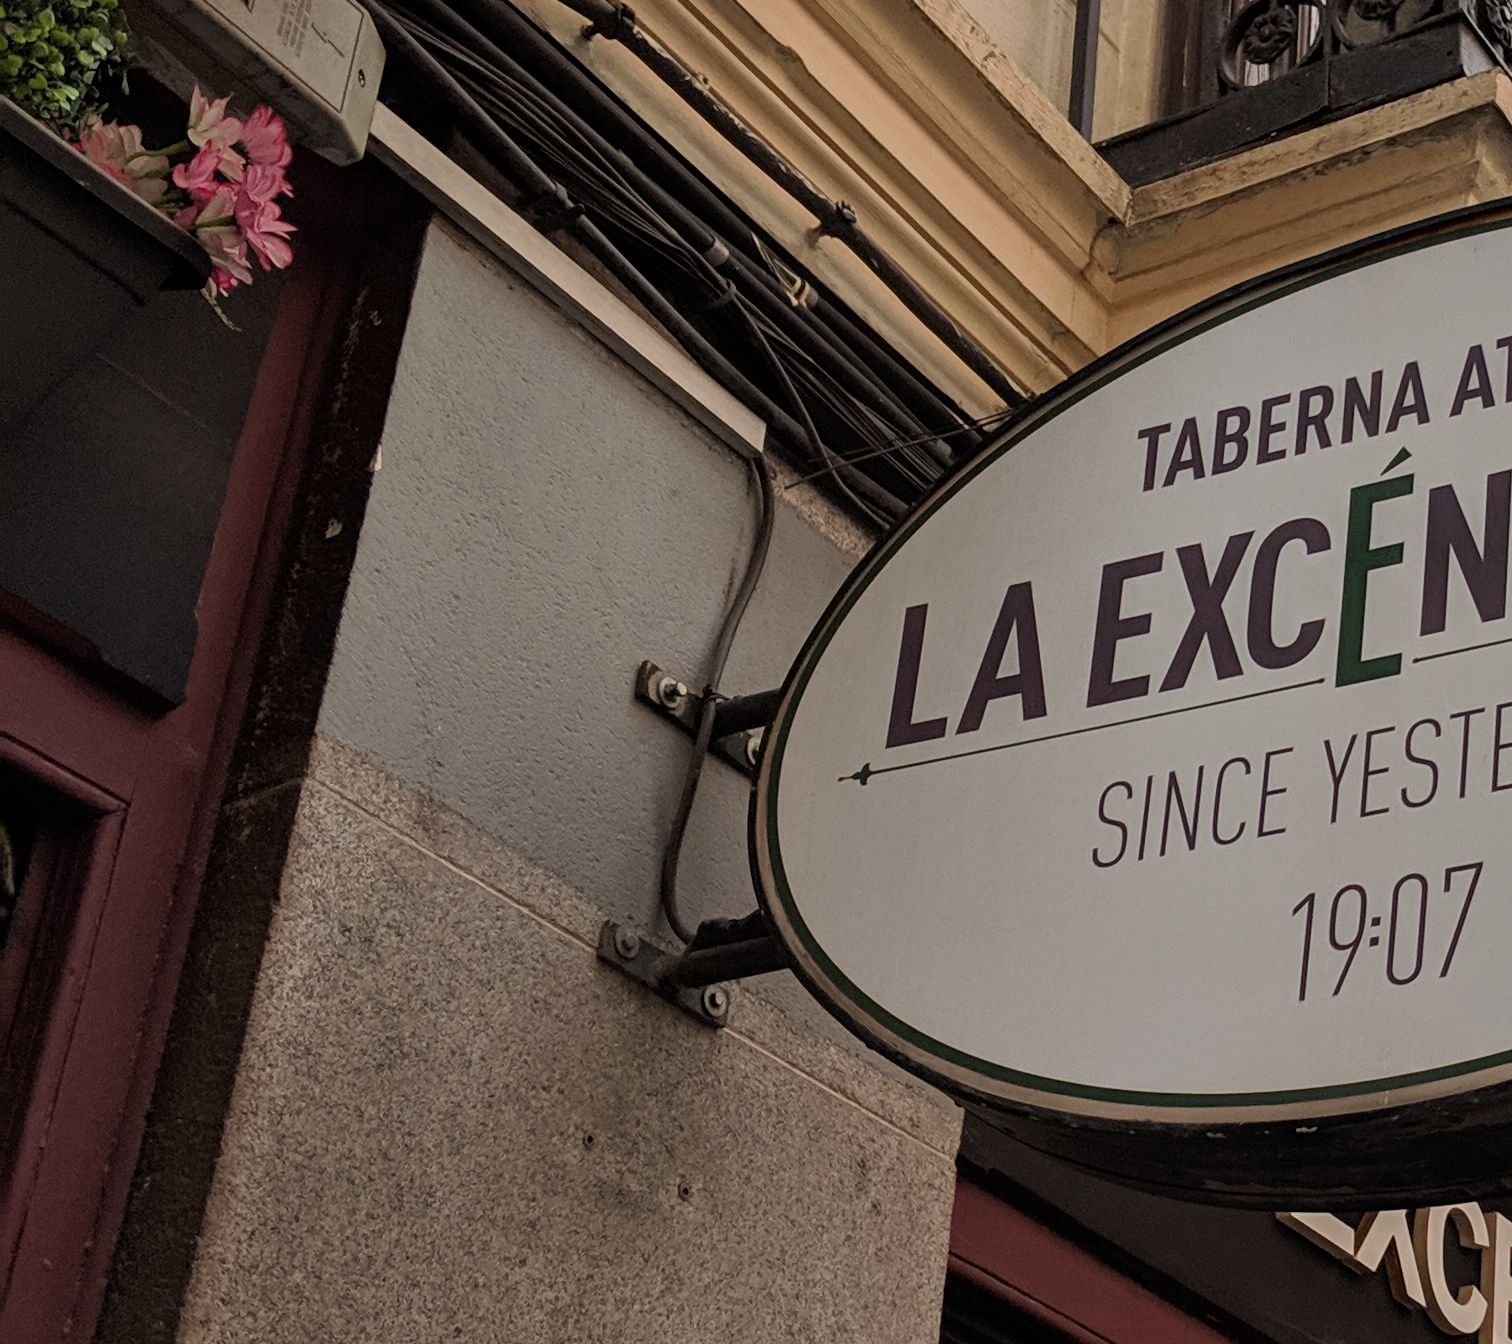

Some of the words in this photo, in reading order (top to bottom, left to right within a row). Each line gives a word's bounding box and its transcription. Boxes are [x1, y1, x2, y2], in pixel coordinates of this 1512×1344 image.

[1137, 359, 1430, 494] TABERNA
[884, 581, 1049, 748] LA
[1091, 746, 1295, 869] SINCE
[1289, 862, 1485, 1003] 19:07
